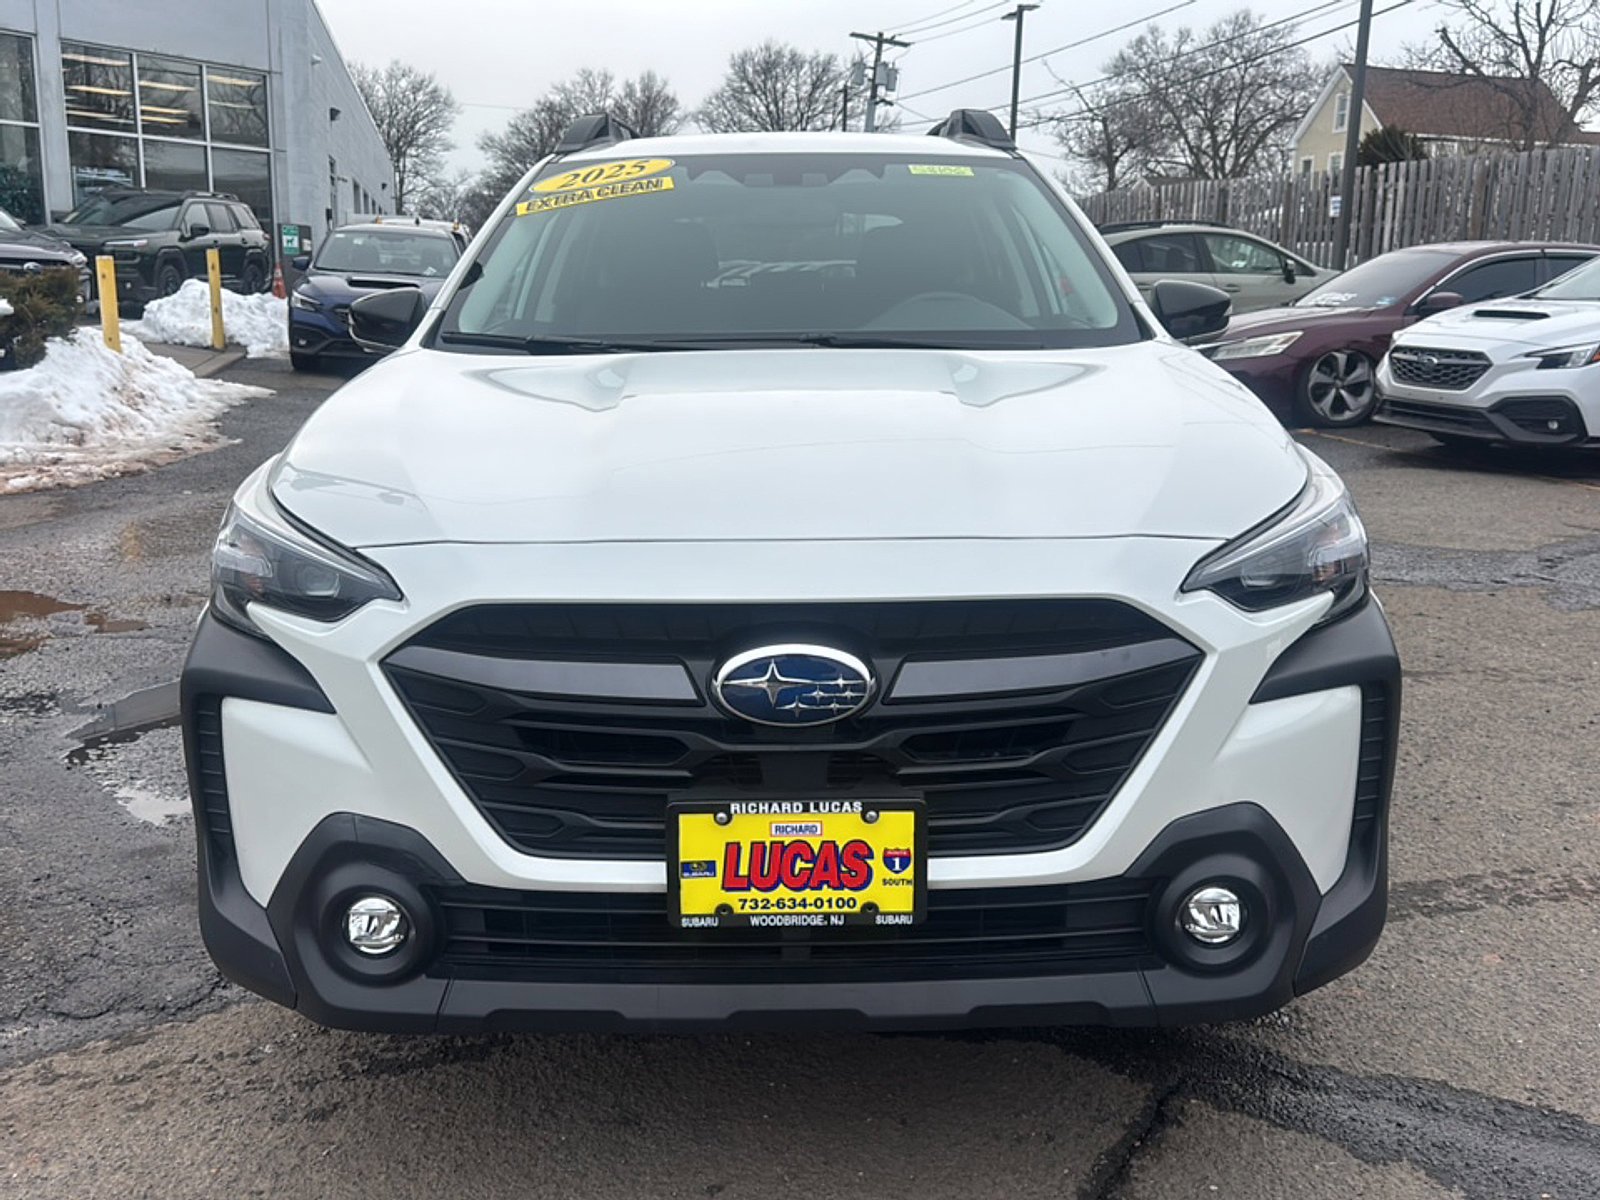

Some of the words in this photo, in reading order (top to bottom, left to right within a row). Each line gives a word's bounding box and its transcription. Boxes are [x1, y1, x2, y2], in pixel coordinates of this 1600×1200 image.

[557, 160, 650, 189] 2025
[526, 191, 593, 212] EXTRA
[730, 802, 803, 815] RICHARD
[809, 801, 863, 814] LUCAS
[774, 824, 819, 836] RICHARD
[721, 839, 875, 892] LUCAS
[892, 856, 902, 871] 1
[882, 878, 913, 887] SOUTH
[738, 897, 857, 910] 732-634-0100
[681, 916, 719, 928] SUBARU
[830, 914, 845, 926] NJ
[875, 914, 914, 926] SUBARU
